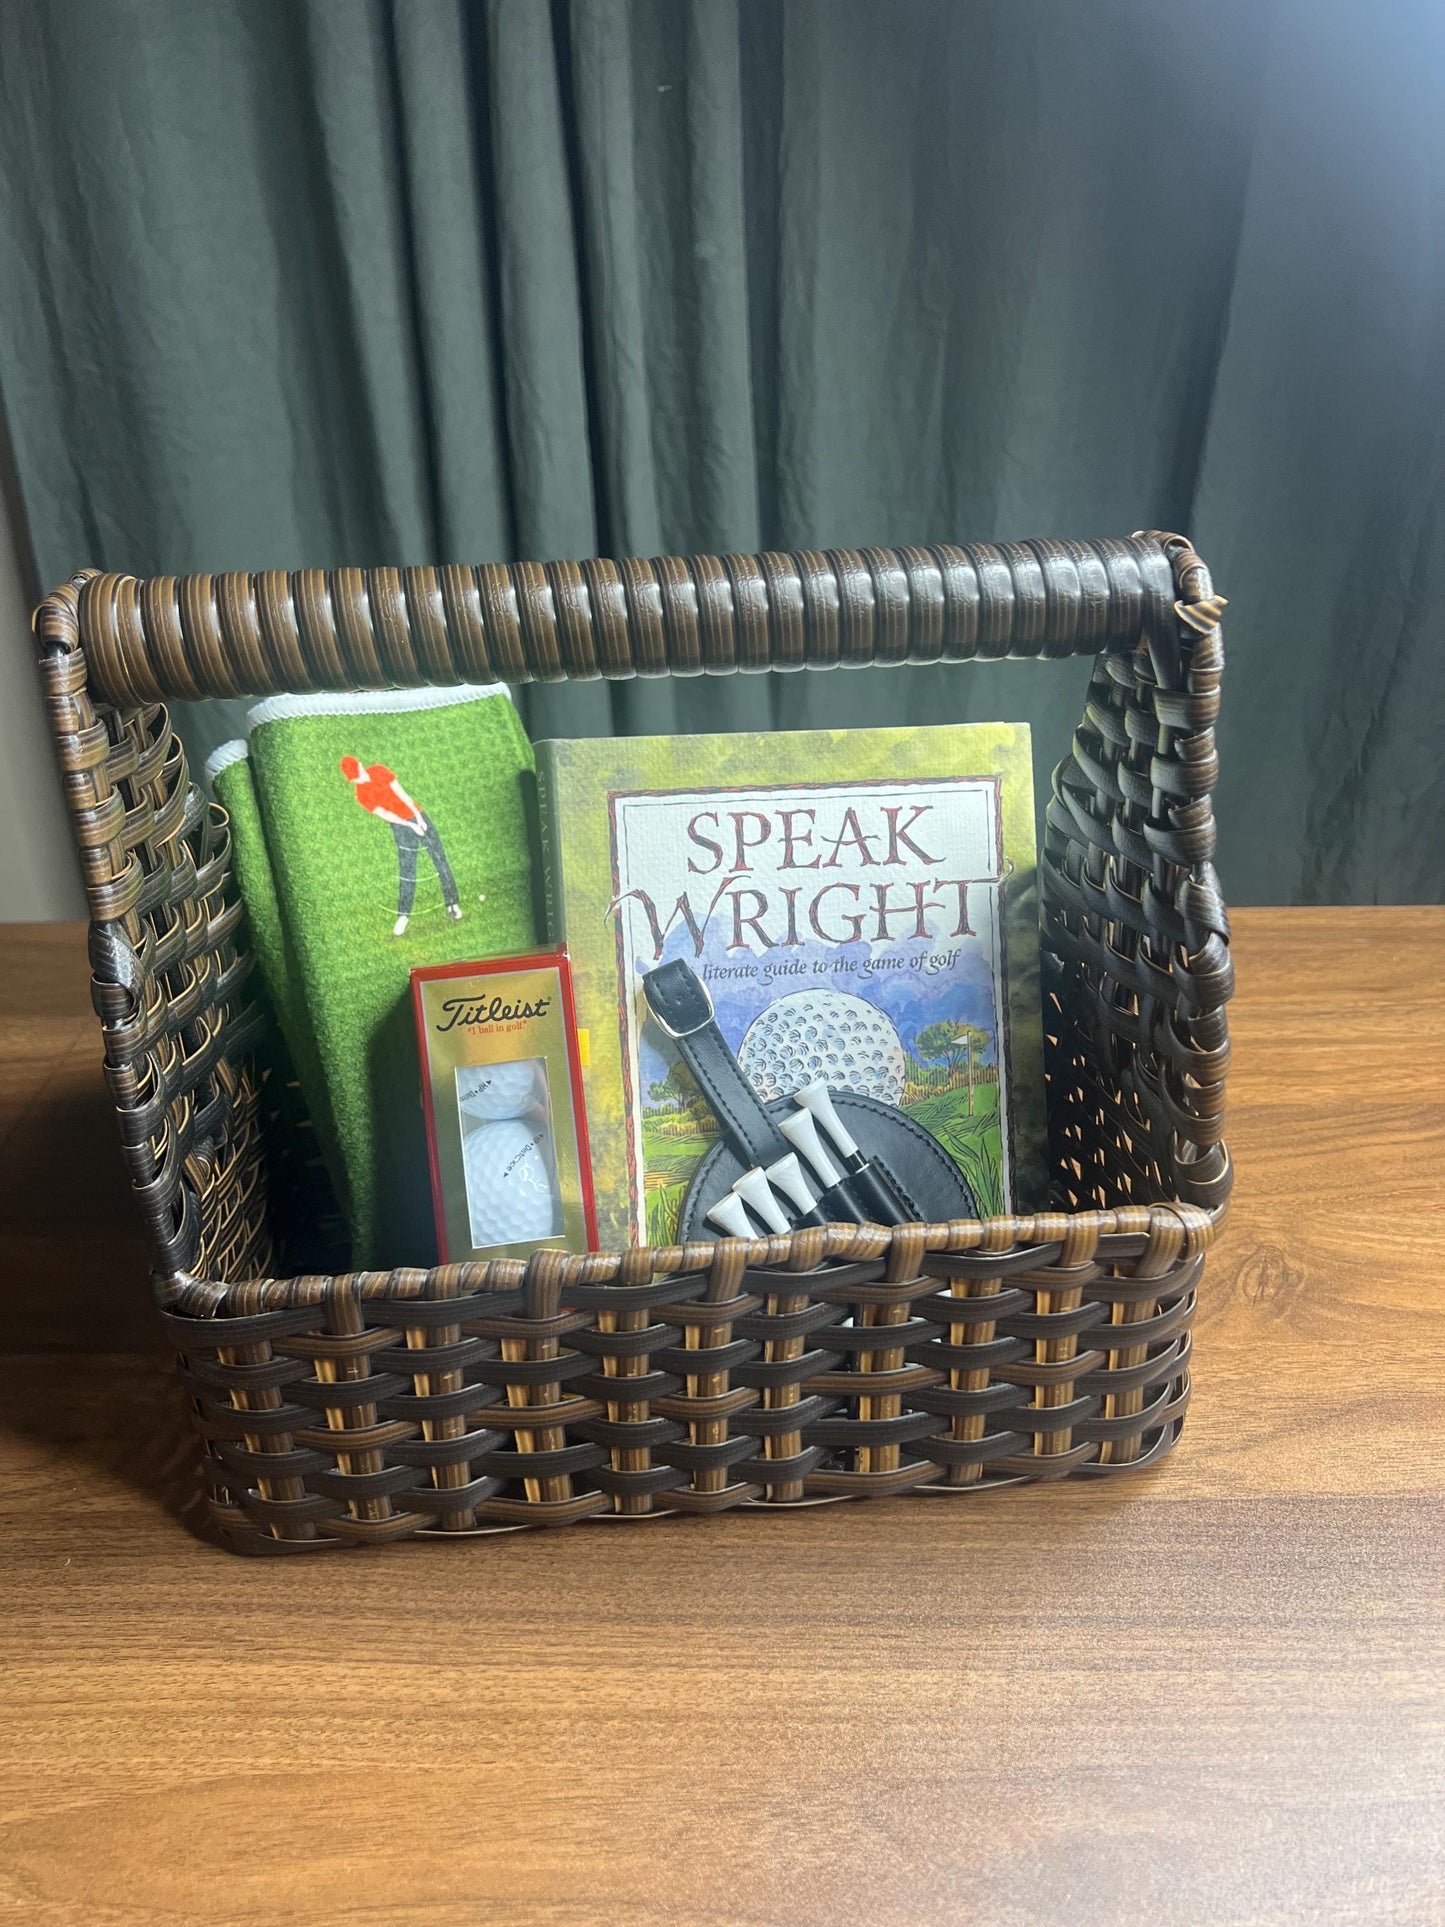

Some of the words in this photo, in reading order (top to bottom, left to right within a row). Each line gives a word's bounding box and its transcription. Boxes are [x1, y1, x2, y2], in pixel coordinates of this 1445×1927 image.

[687, 806, 947, 875] SPEAK
[544, 866, 555, 938] WRIG
[604, 856, 1014, 960] WRIGHT
[702, 963, 759, 981] literate
[757, 958, 808, 986] guide
[812, 959, 828, 974] to
[832, 955, 858, 973] the
[857, 956, 904, 980] game
[909, 950, 928, 973] of
[925, 948, 962, 976] golf
[436, 994, 550, 1032] Titleist
[478, 1023, 494, 1034] ball
[496, 1022, 504, 1032] in
